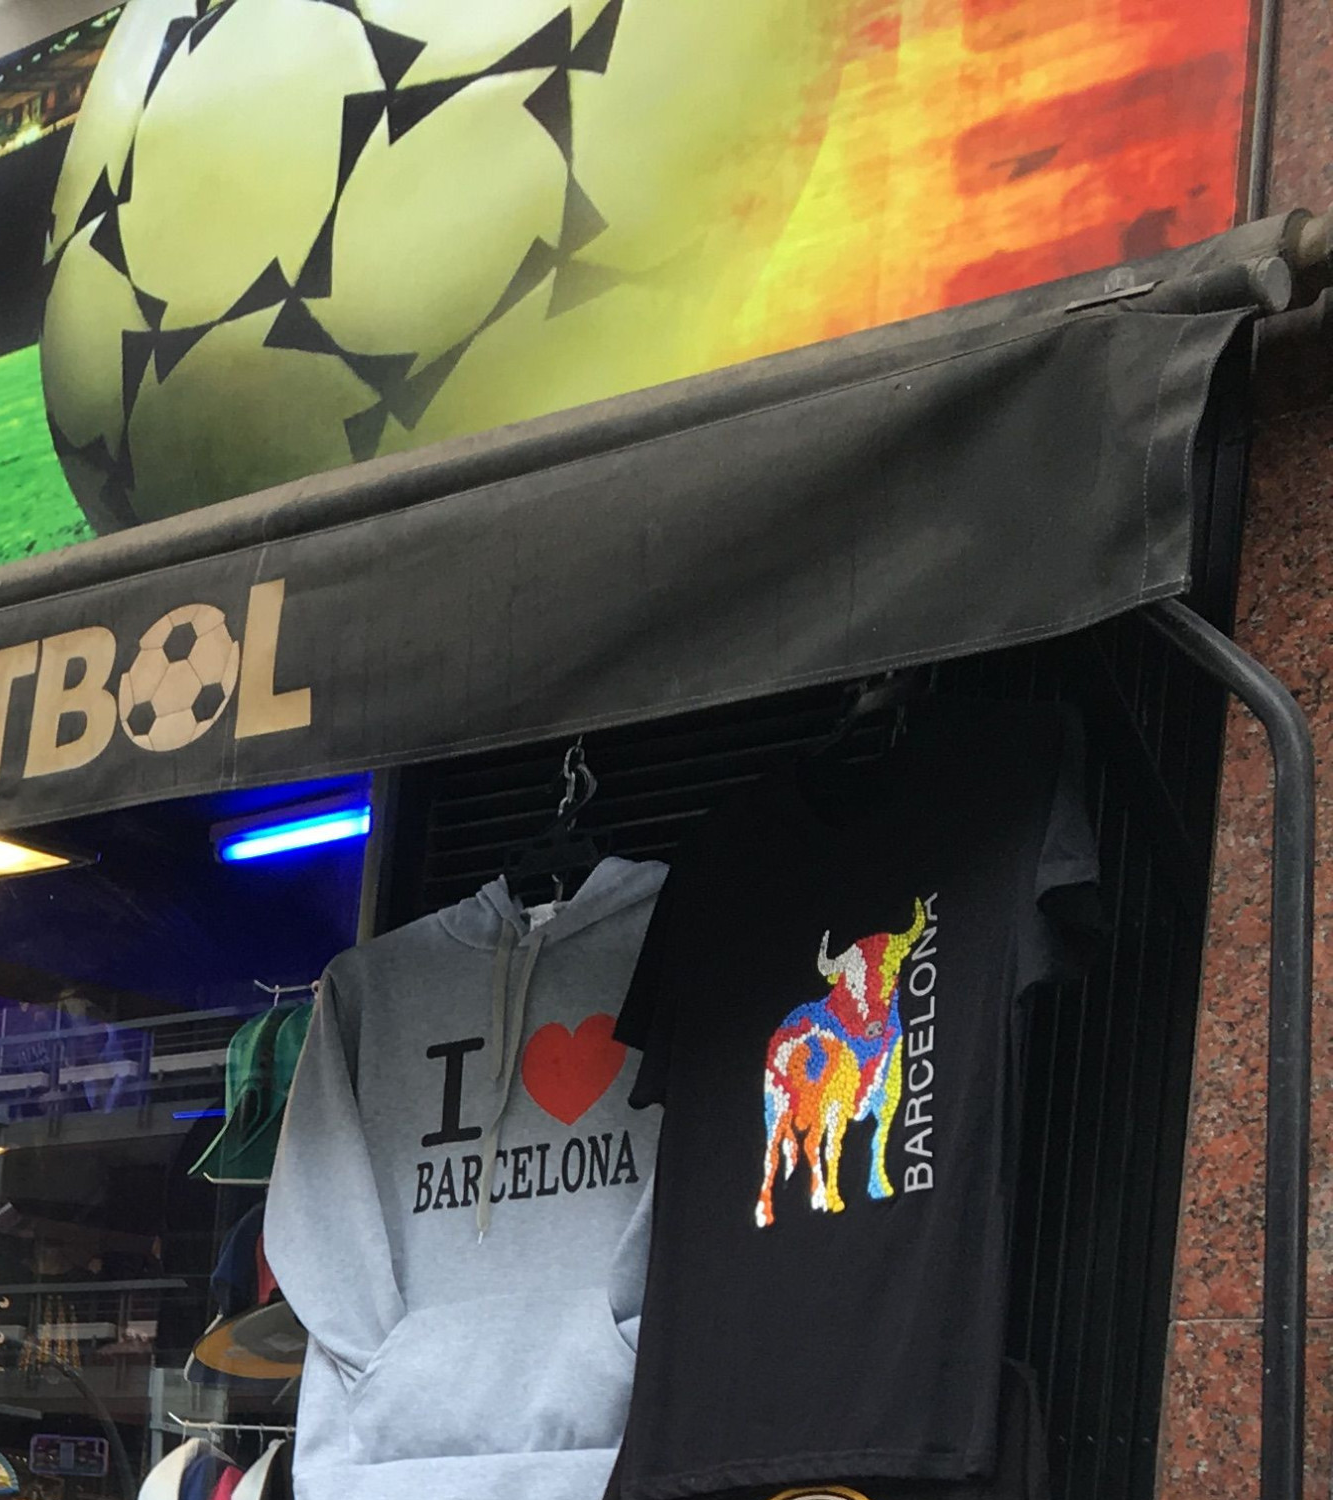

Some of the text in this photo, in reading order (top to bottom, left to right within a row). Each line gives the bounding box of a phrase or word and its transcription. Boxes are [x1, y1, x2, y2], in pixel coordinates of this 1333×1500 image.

[422, 1037, 485, 1147] I
[903, 892, 938, 1192] BARCELONA
[413, 1130, 639, 1213] BARCELONA
